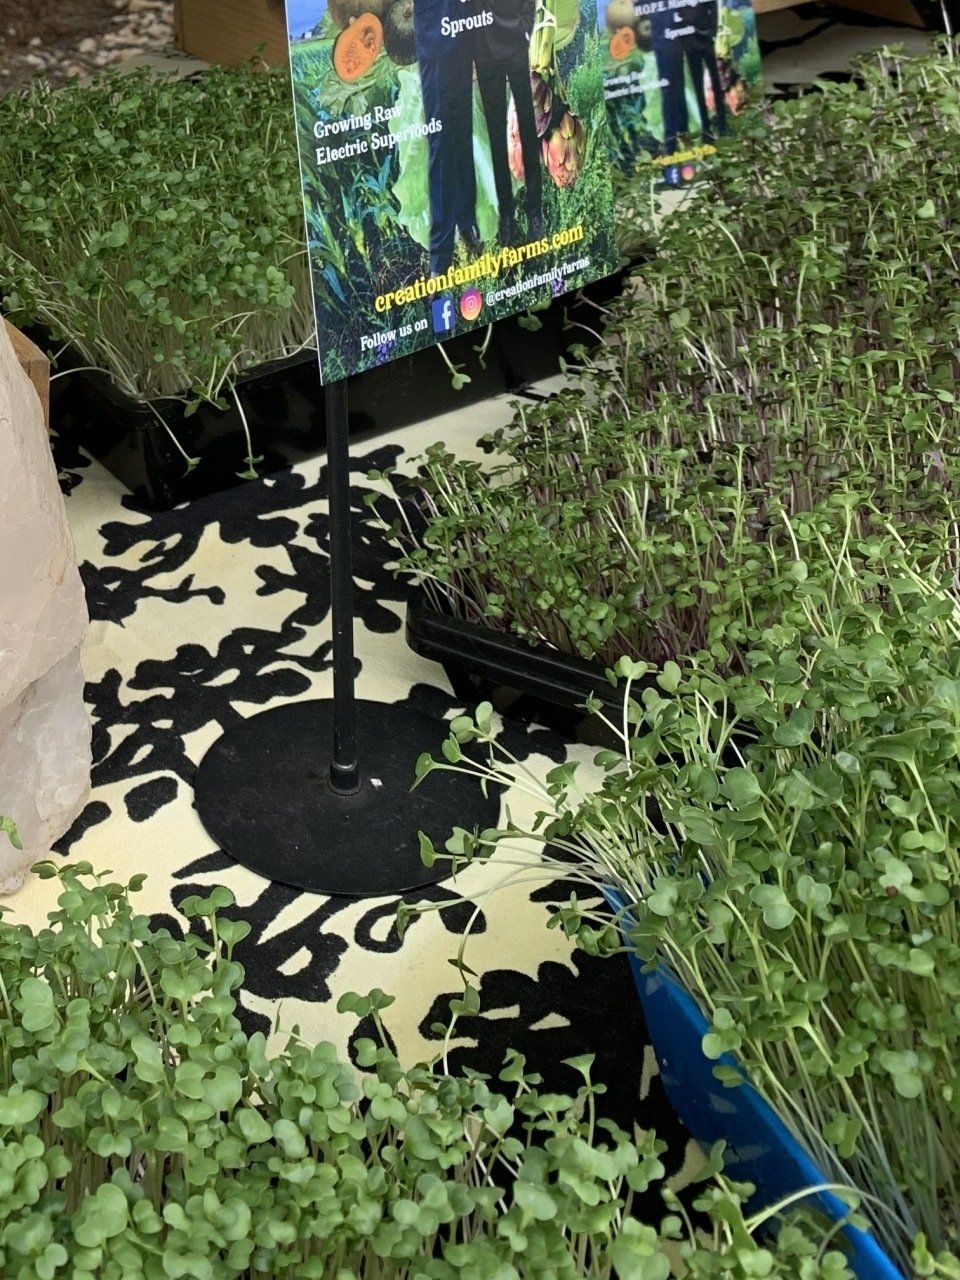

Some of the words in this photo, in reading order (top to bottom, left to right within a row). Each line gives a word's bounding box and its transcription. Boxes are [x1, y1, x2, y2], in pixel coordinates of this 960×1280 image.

[440, 10, 494, 40] Sprouts
[313, 112, 373, 140] Growing
[374, 106, 401, 123] Raw
[316, 140, 369, 166] Electric
[370, 117, 443, 152] Superfoods
[375, 222, 584, 313] creationfamilyfarms.com
[360, 329, 397, 351] Follow
[399, 325, 414, 336] us
[416, 318, 428, 331] on
[485, 256, 591, 307] @creationfamilyfarms
